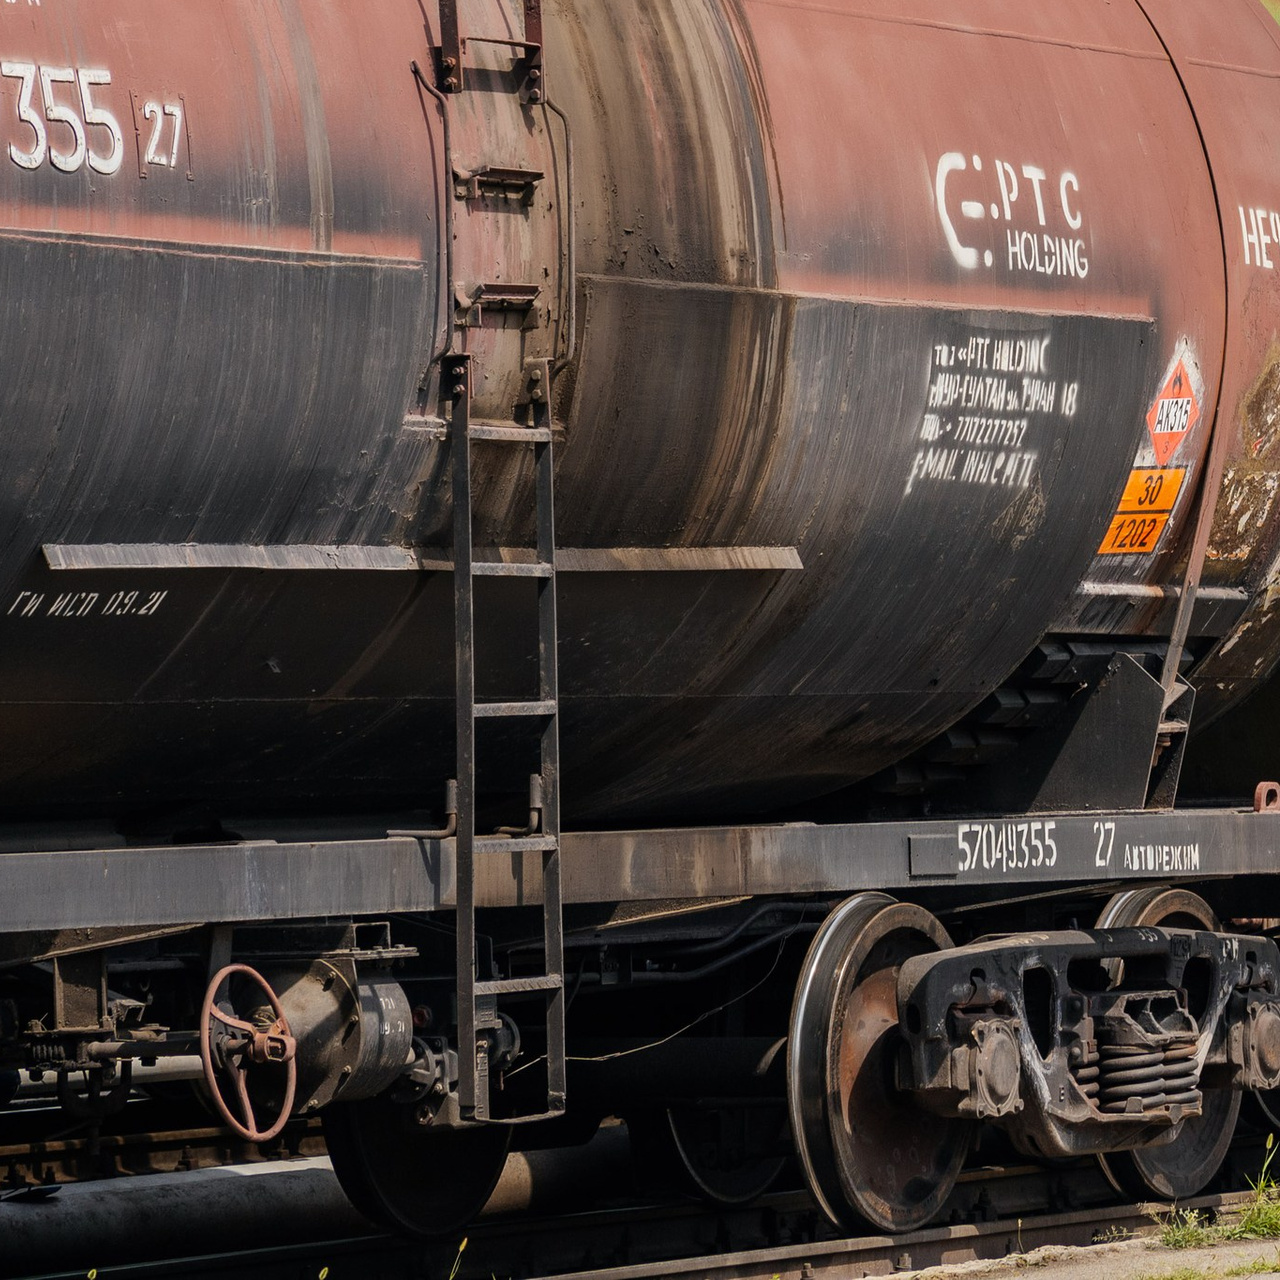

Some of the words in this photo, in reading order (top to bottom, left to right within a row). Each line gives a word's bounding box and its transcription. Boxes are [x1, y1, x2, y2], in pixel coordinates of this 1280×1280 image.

[0, 61, 124, 174] 355
[143, 101, 182, 168] 27
[995, 159, 1082, 231] PTC
[1007, 228, 1089, 279] HOLDING
[1061, 381, 1079, 416] 18
[1162, 441, 1170, 454] 3
[1138, 474, 1164, 506] 30
[1110, 518, 1157, 549] 1202
[958, 821, 1057, 872] 57049355
[1093, 822, 1116, 867] 27
[1124, 843, 1200, 871] АВТОРЕЖИМ
